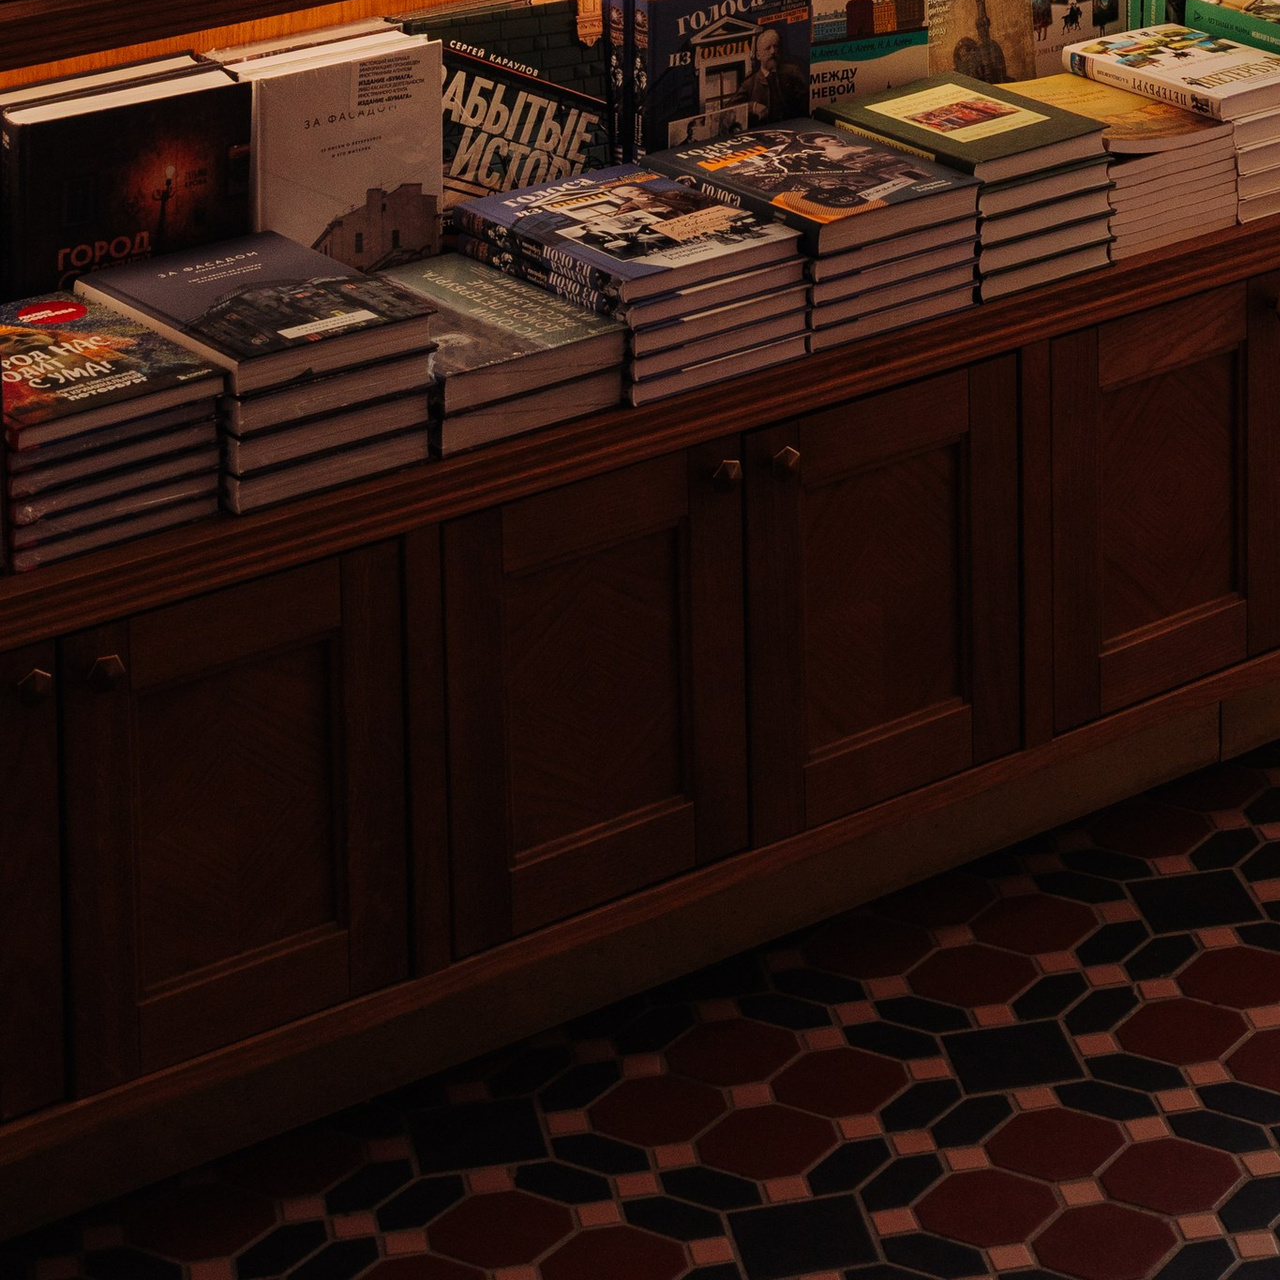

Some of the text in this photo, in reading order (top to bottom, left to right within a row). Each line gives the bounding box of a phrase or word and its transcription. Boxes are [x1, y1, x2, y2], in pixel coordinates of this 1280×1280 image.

[449, 40, 540, 77] СЕРГЕЙ КАРАУЛОВ
[810, 68, 858, 85] МЕЖДУ
[812, 81, 856, 99] НЕВОЙ
[304, 118, 321, 130] ЗА
[57, 230, 151, 271] ГОРОД
[158, 270, 178, 279] ЗА
[183, 251, 259, 273] ФАСАДОМ
[49, 336, 110, 357] НАС
